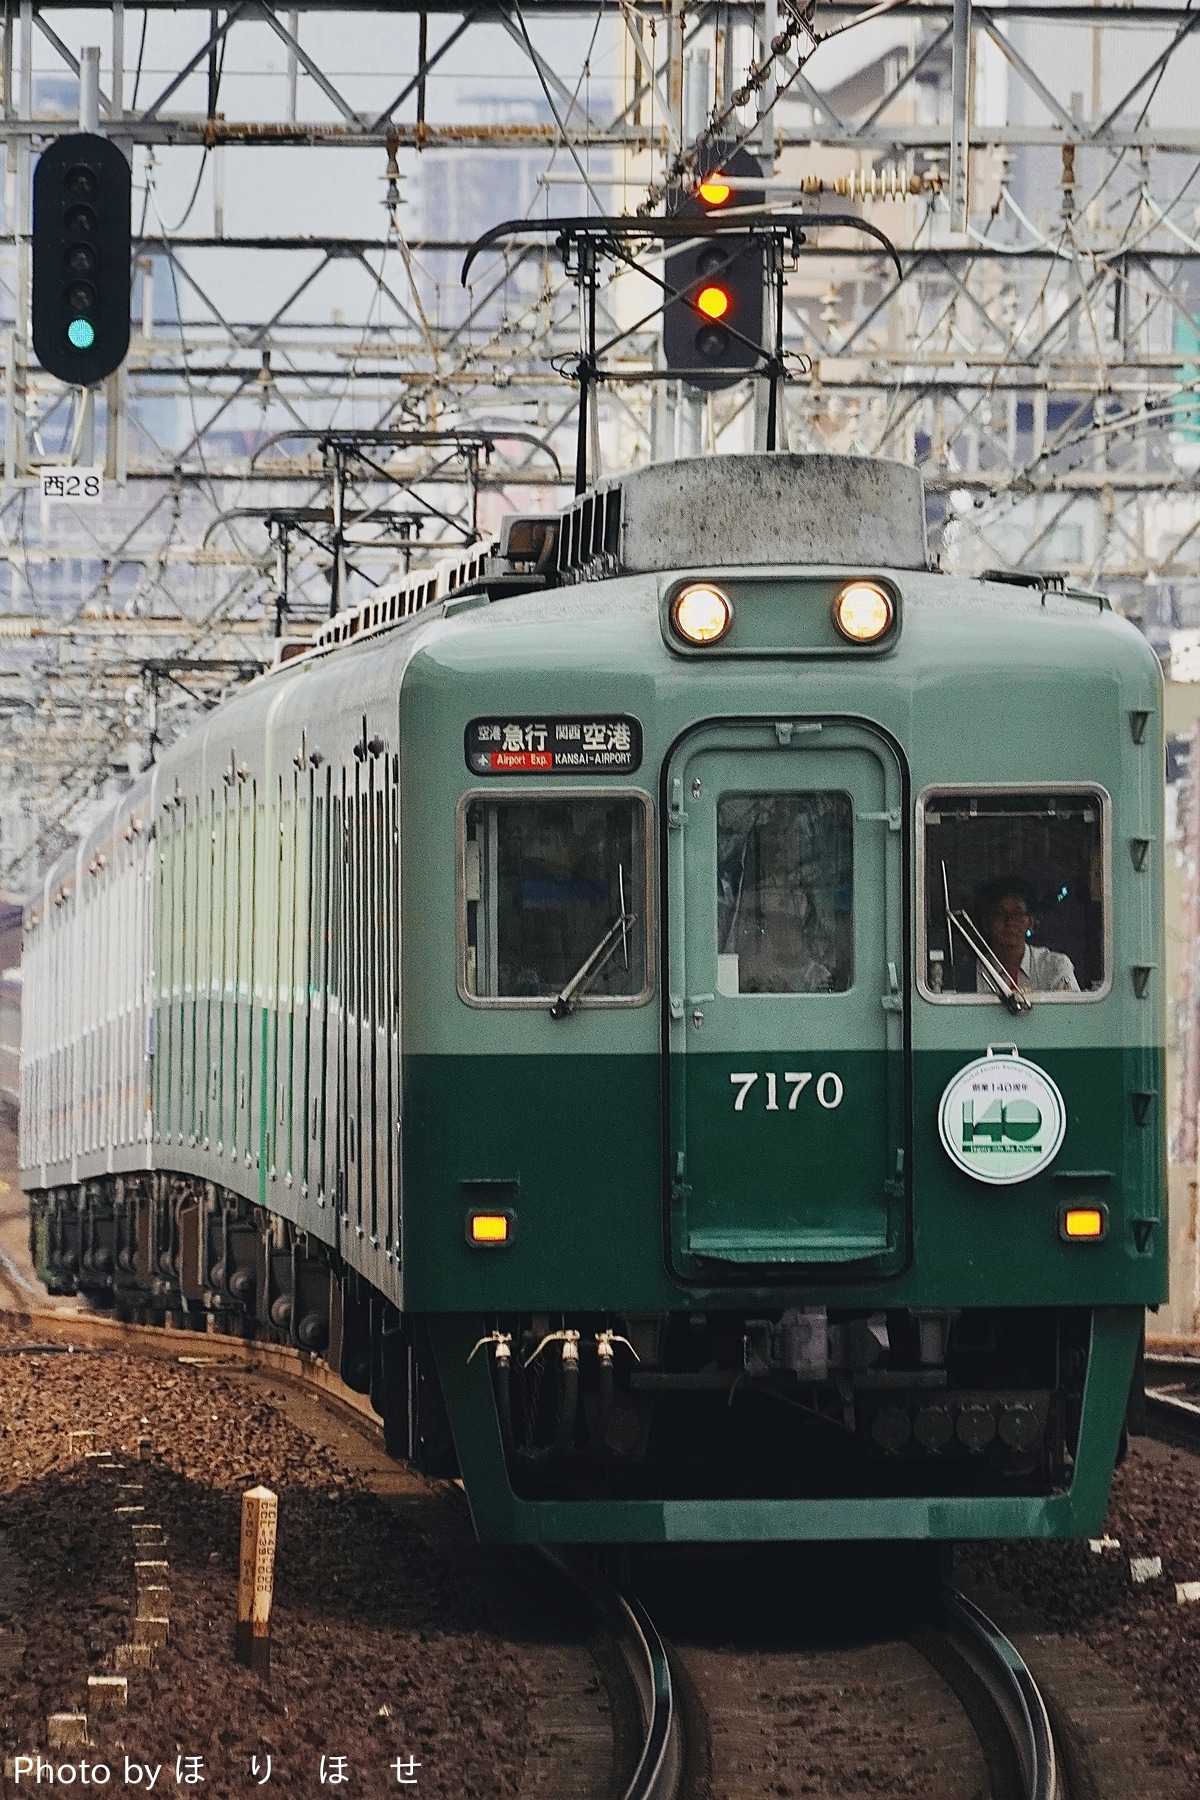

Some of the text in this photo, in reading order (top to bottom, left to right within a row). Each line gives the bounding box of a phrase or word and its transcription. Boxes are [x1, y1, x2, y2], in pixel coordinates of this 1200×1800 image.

[44, 475, 100, 497] 西28
[477, 722, 631, 752] 空港急行 関西空港
[496, 753, 526, 767] Airport
[530, 753, 548, 767] Exp.
[730, 1071, 844, 1111] 7170
[962, 1099, 1042, 1142] 140
